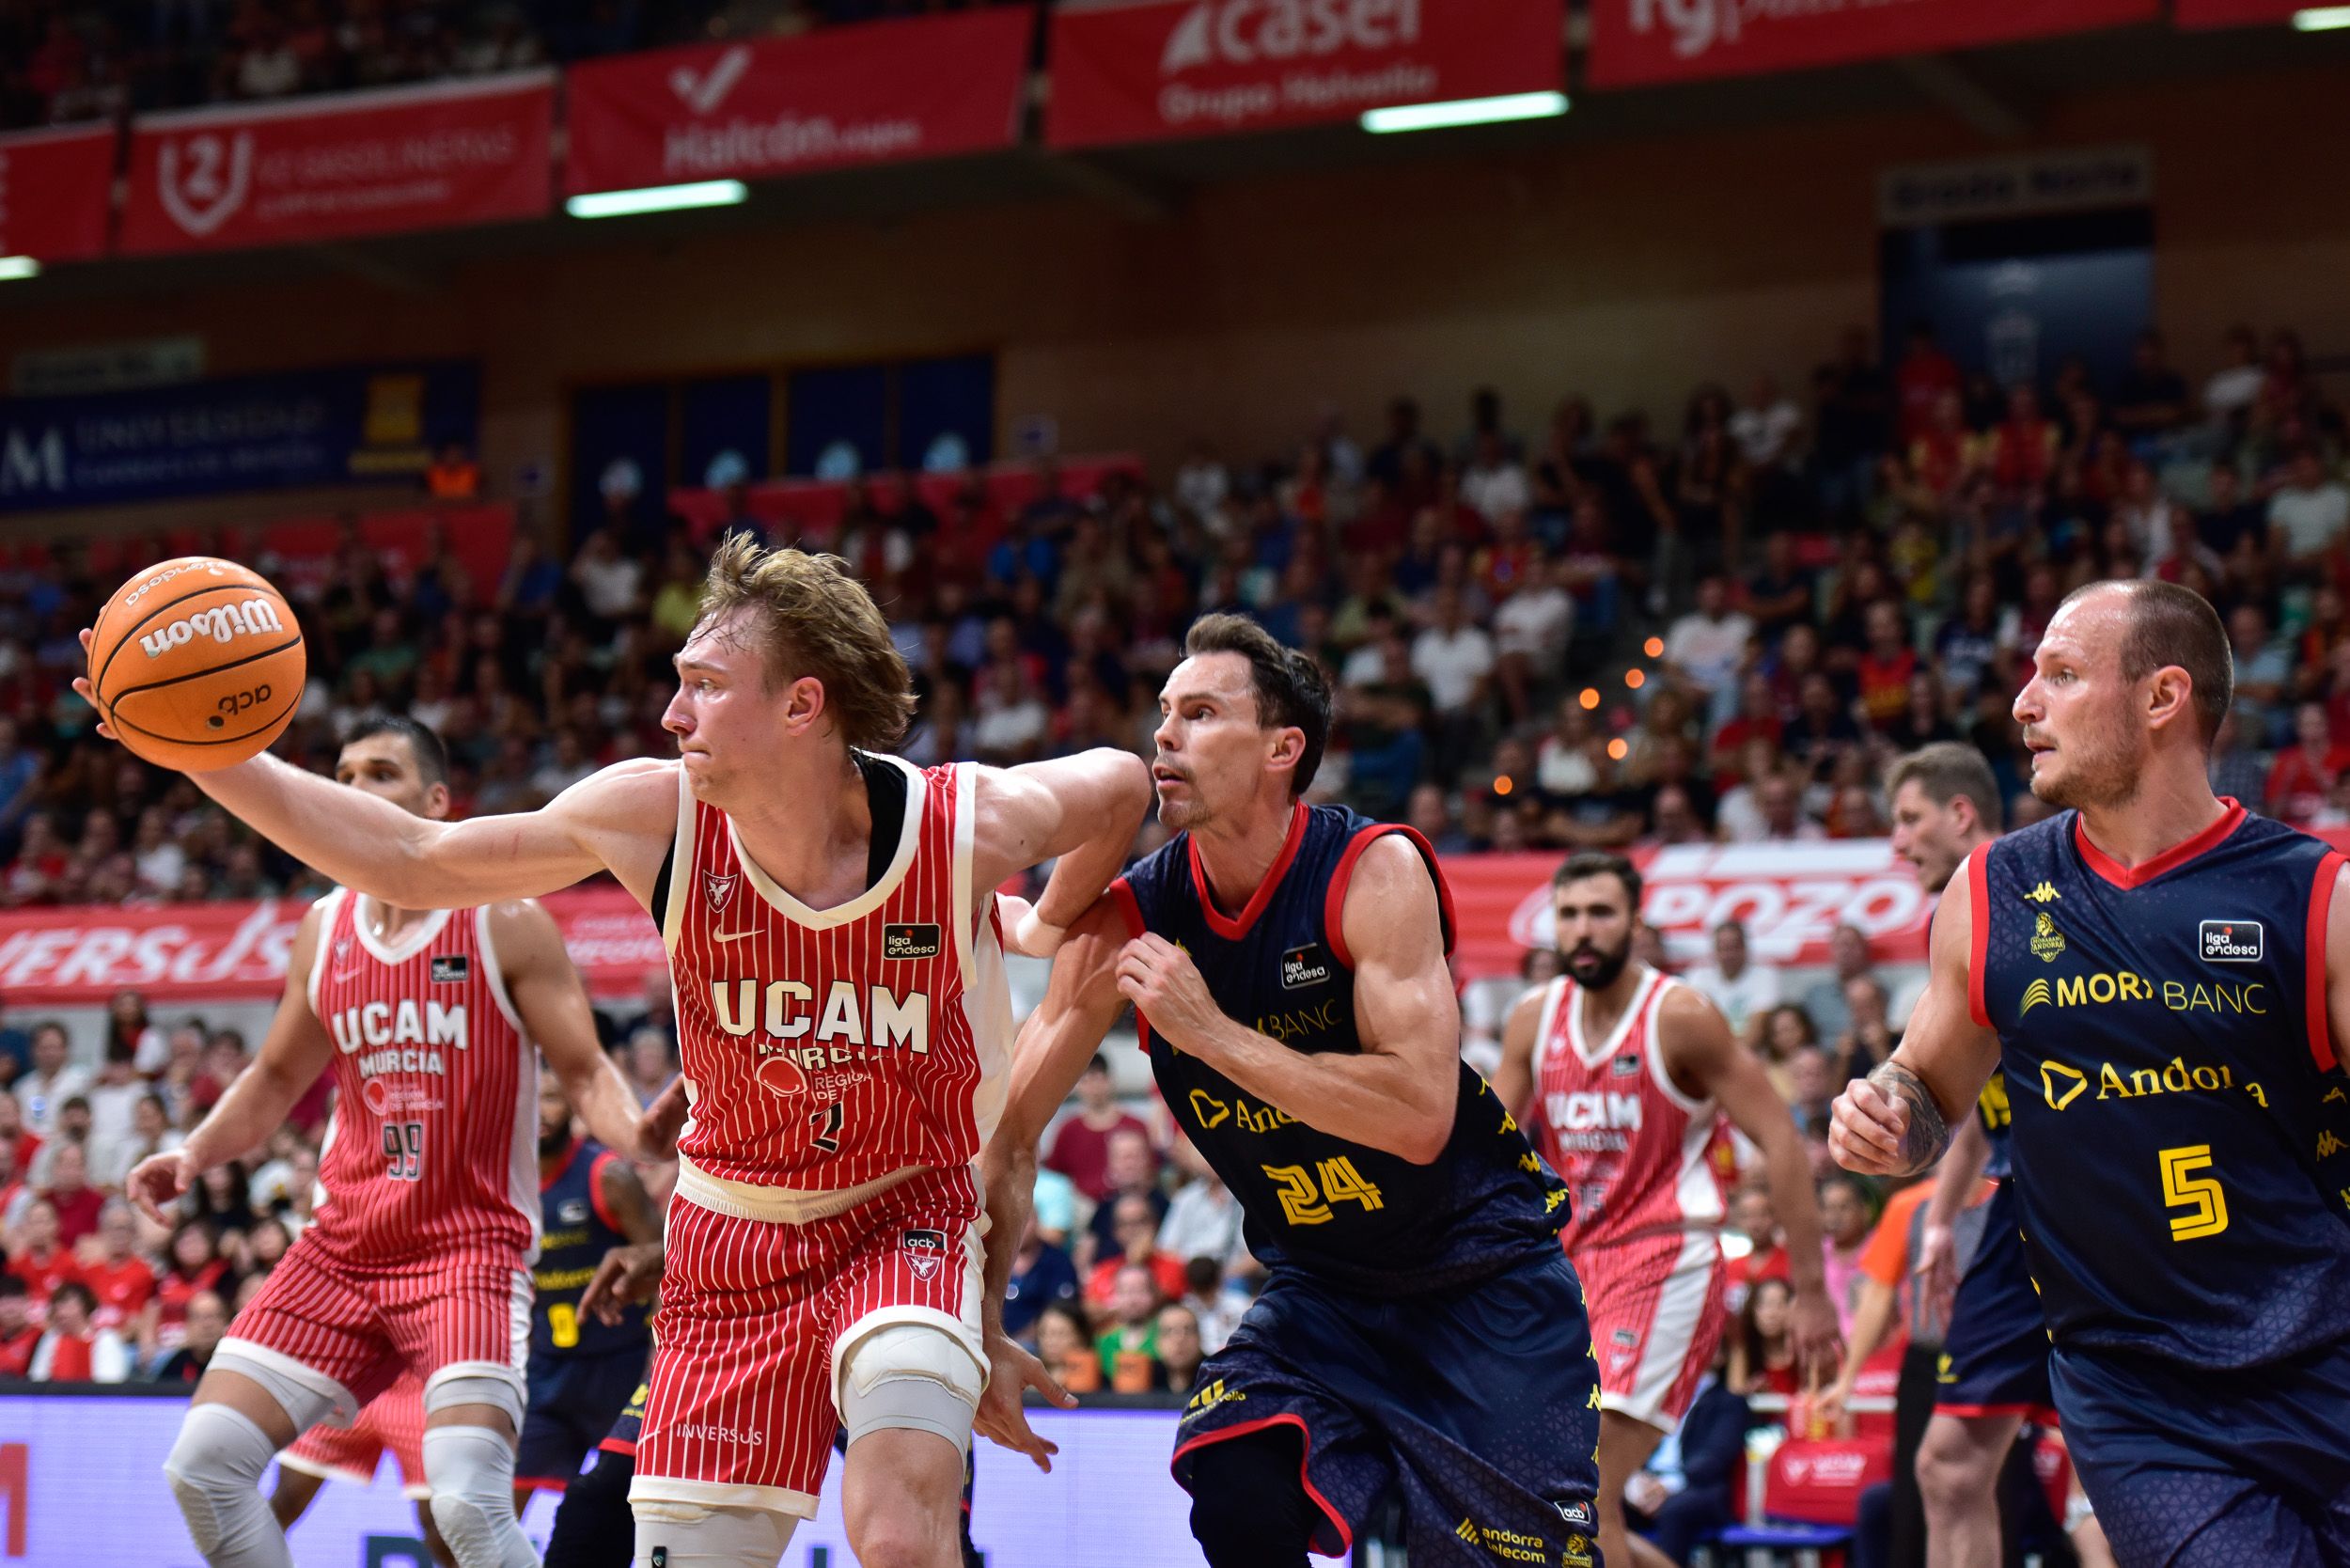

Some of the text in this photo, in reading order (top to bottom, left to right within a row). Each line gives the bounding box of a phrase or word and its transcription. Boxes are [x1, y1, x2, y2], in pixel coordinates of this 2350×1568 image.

[139, 598, 284, 658] Wilson
[217, 683, 273, 715] acb
[888, 935, 911, 948] liga
[2206, 932, 2230, 945] liga
[888, 945, 935, 955] endesa
[2206, 944, 2257, 955] endesa
[1285, 961, 1304, 974] liga
[1286, 966, 1325, 983] endesa
[332, 998, 469, 1055] UCAM
[712, 979, 930, 1055] UCAM
[358, 1048, 446, 1079] MURCIA
[816, 1090, 838, 1101] DE
[1544, 1090, 1643, 1133] UCAM
[382, 1121, 424, 1181] 99
[1260, 1154, 1385, 1226] 24
[2158, 1144, 2229, 1242] 5
[907, 1238, 936, 1248] acb
[676, 1423, 763, 1447] INVERSUS
[1563, 1507, 1585, 1520] acb
[1481, 1529, 1543, 1548] andorra
